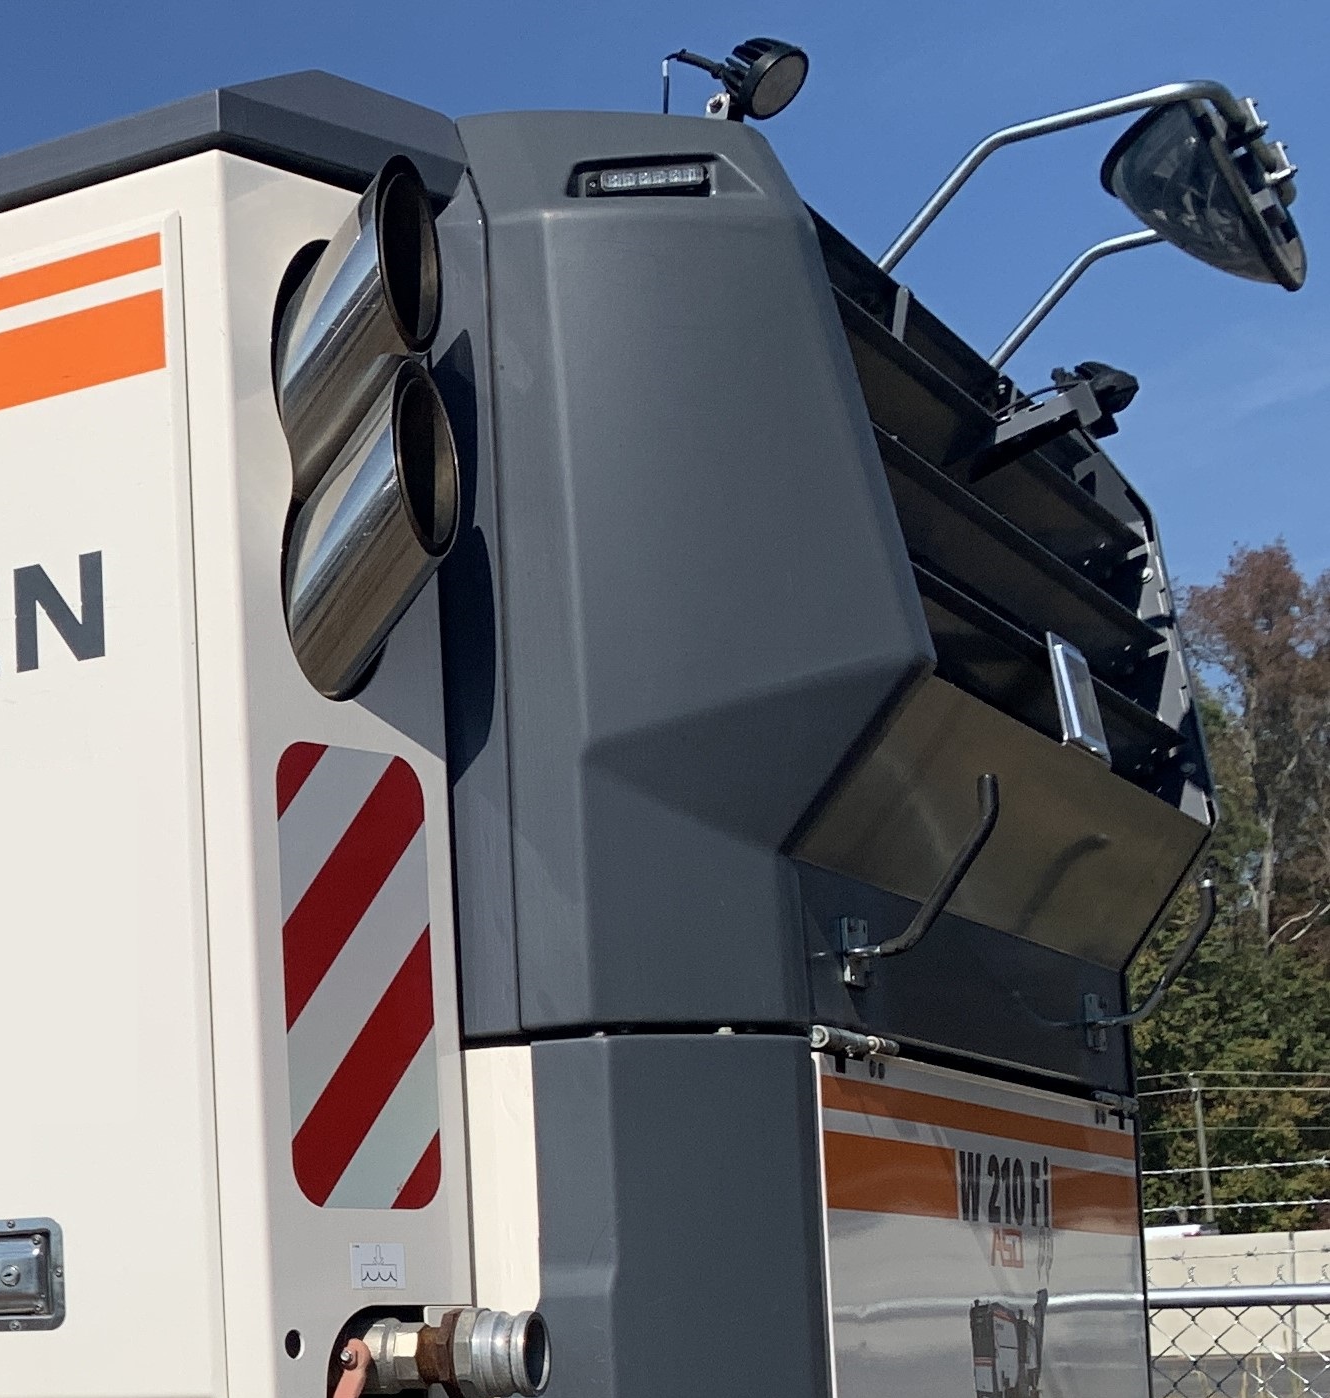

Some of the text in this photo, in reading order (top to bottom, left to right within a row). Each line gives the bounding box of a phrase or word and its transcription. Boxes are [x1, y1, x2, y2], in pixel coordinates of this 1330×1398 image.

[959, 1150, 1050, 1228] W 210 Fi
